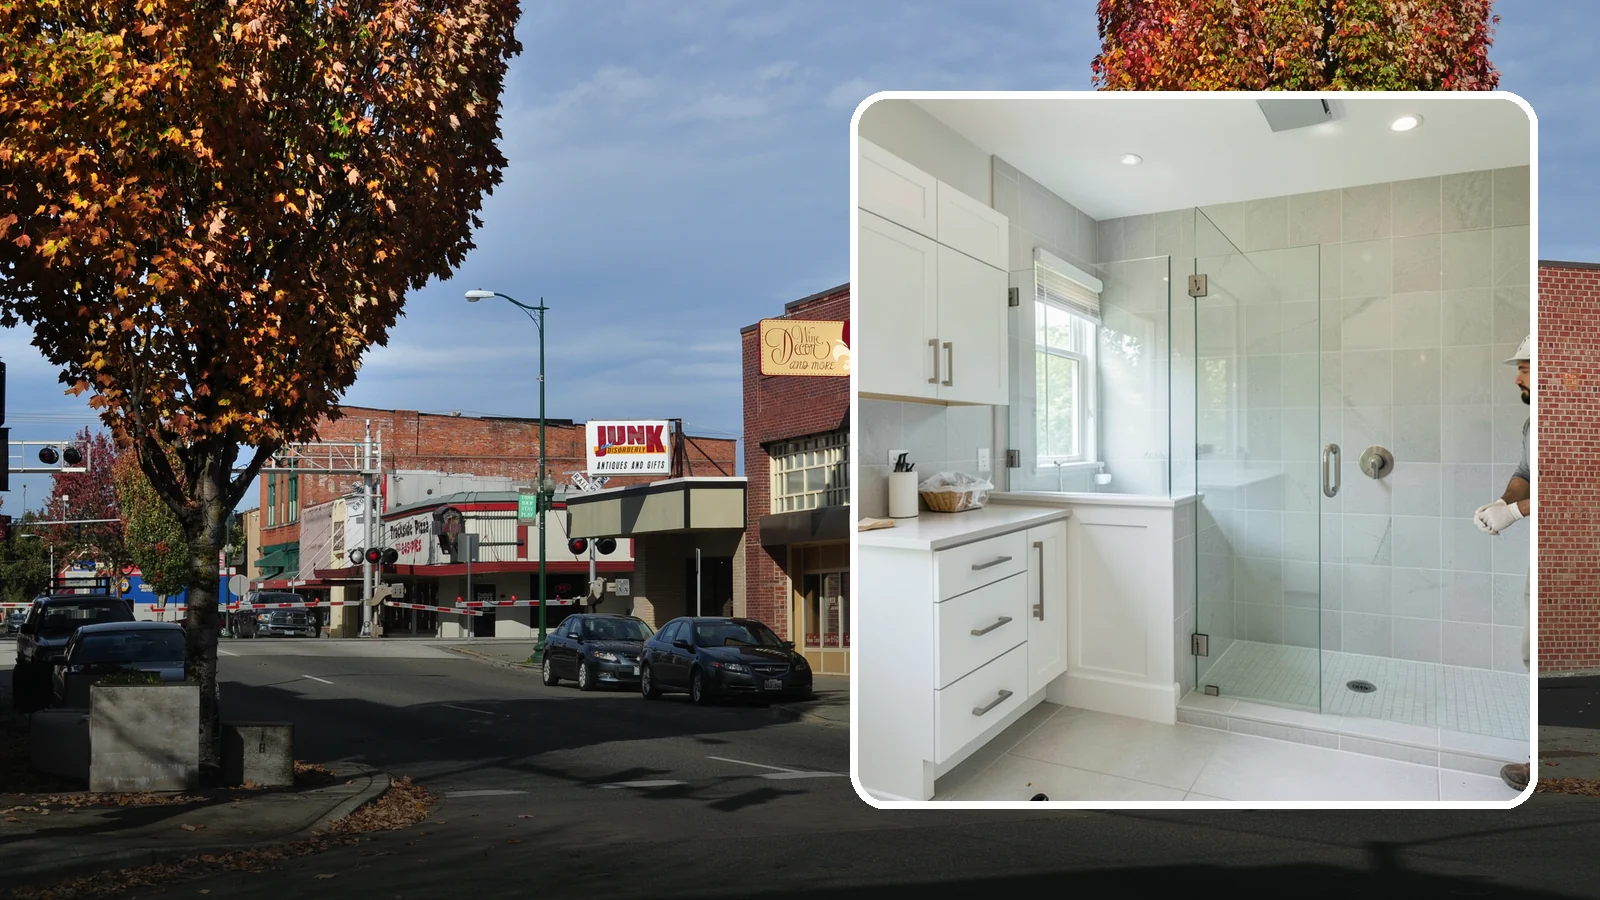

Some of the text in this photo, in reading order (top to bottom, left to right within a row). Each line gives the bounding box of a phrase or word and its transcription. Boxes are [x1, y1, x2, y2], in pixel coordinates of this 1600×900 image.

[765, 327, 830, 365] Decor
[595, 425, 665, 457] JUNK
[607, 446, 646, 454] DISORDERLY
[597, 460, 665, 470] ANTIQUES AND GIFTS
[414, 519, 429, 535] Pizza
